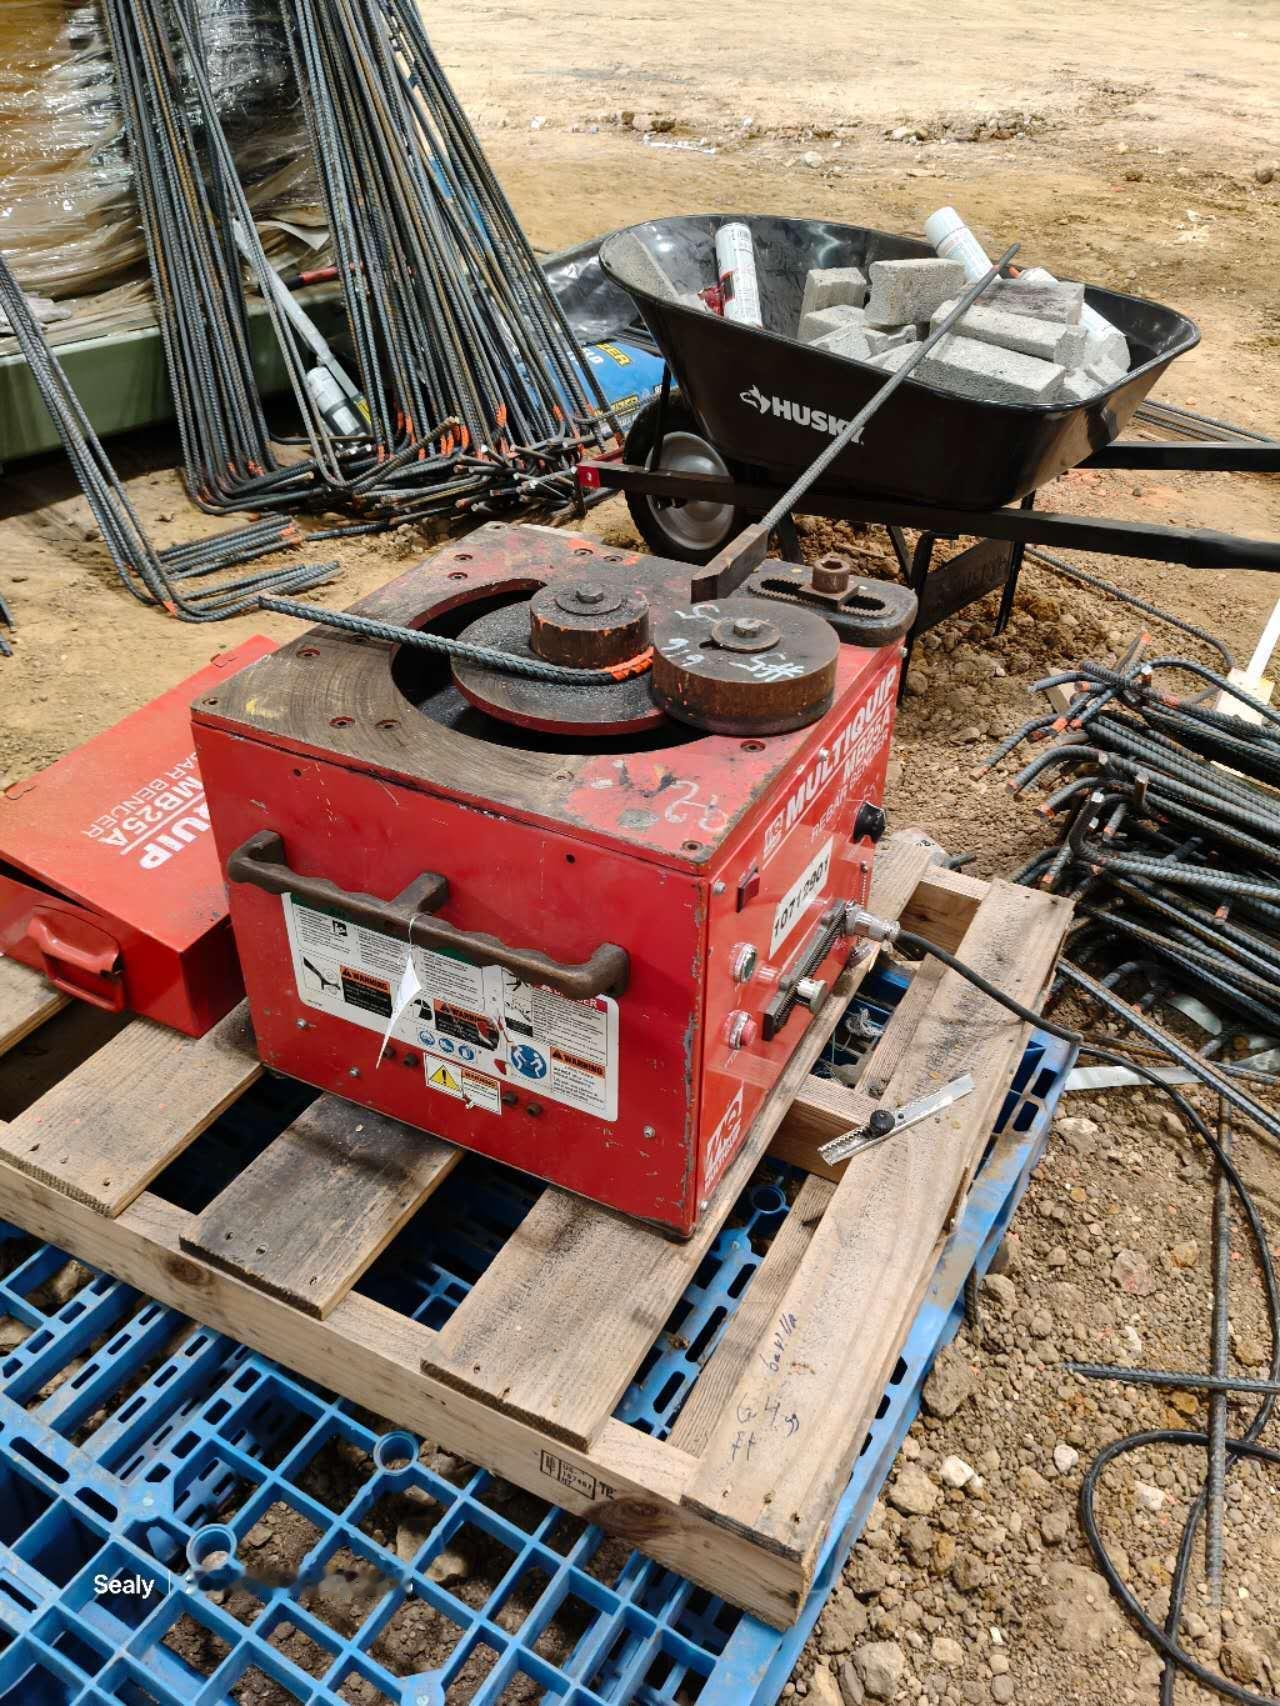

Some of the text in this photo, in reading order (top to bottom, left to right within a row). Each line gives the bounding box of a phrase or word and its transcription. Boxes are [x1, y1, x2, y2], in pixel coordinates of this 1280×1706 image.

[785, 664, 898, 830] MULTIQUIP
[97, 776, 203, 846] MB25A
[562, 1055, 603, 1077] WARNING
